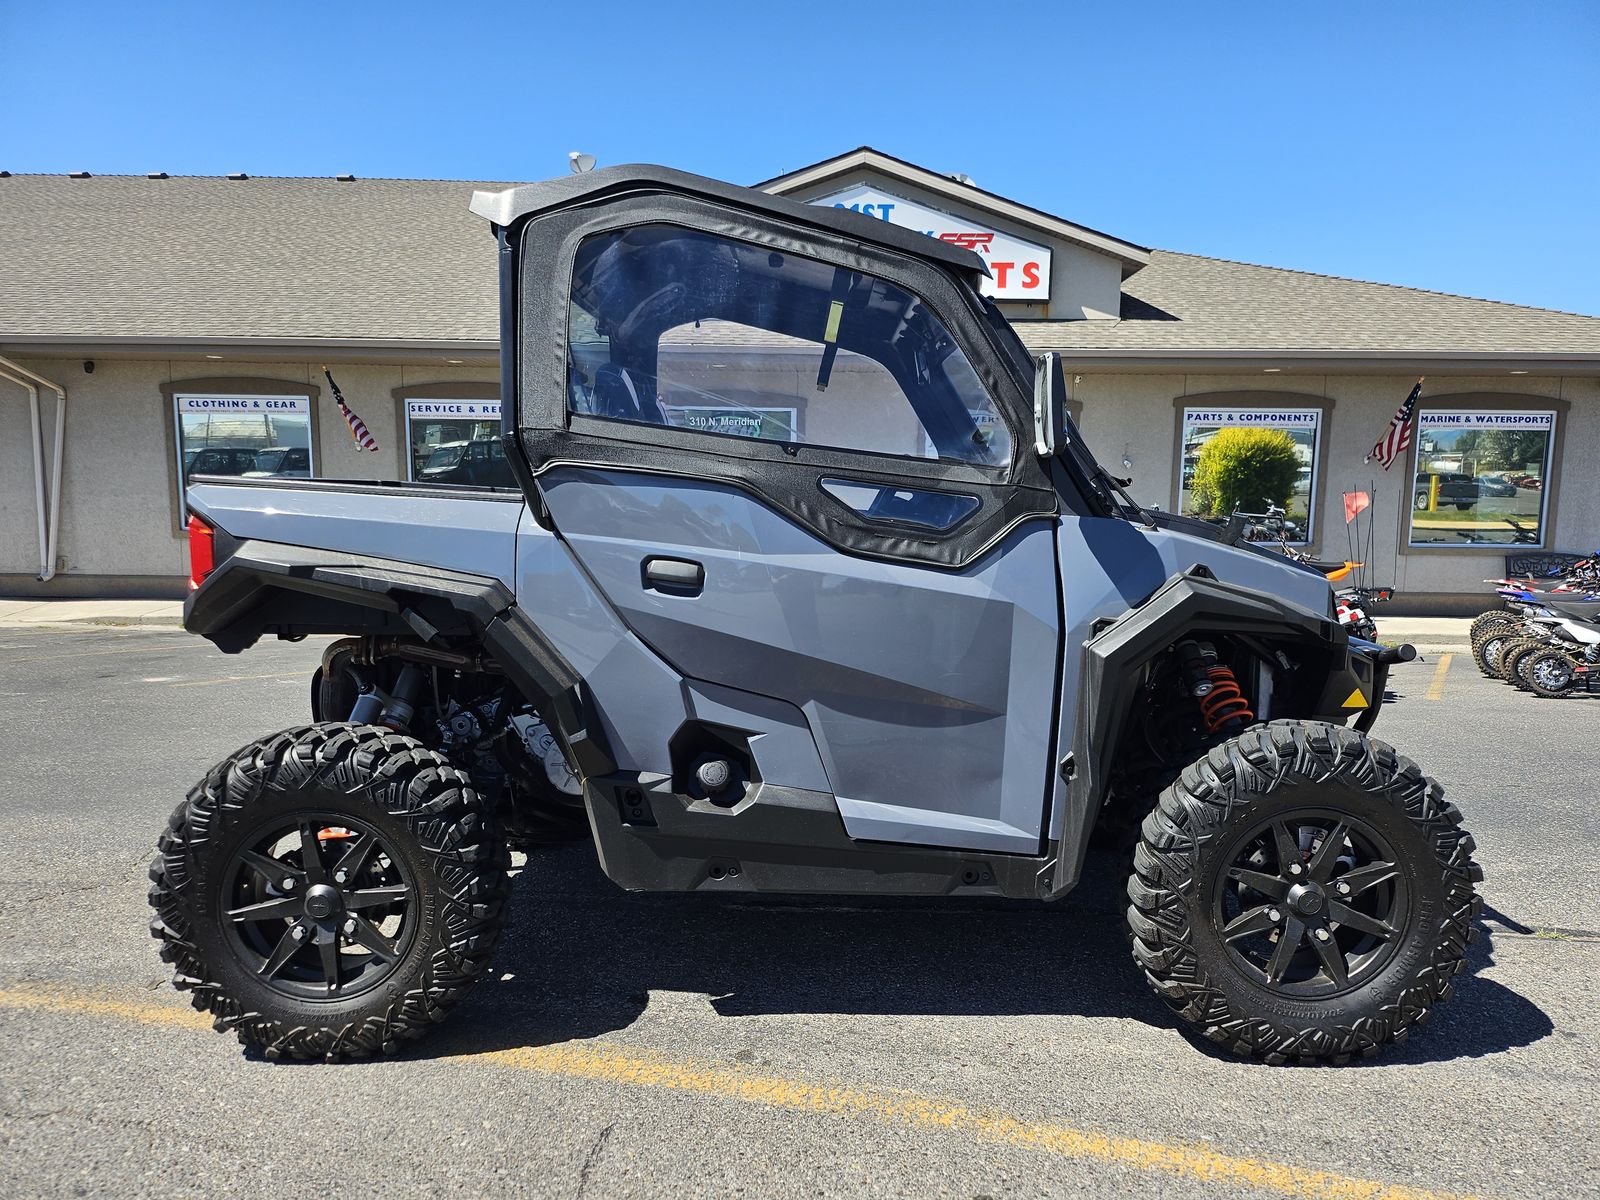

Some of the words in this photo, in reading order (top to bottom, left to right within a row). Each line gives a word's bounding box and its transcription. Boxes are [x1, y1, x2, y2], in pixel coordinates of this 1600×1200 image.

[834, 203, 895, 223] ST
[188, 400, 248, 408] CLOTHING
[253, 400, 260, 408] &
[265, 400, 297, 409] GEAR
[410, 405, 462, 413] SERVICE
[468, 405, 476, 413] &
[689, 417, 706, 426] 310
[708, 417, 718, 426] N.
[720, 417, 761, 426] Meridian
[1187, 413, 1222, 421] PARTS
[1226, 413, 1234, 421] &
[1239, 413, 1315, 422] COMPONENTS
[1420, 415, 1461, 423] MARINE
[1464, 415, 1472, 423] &
[1475, 415, 1551, 424] WATERSPORTS
